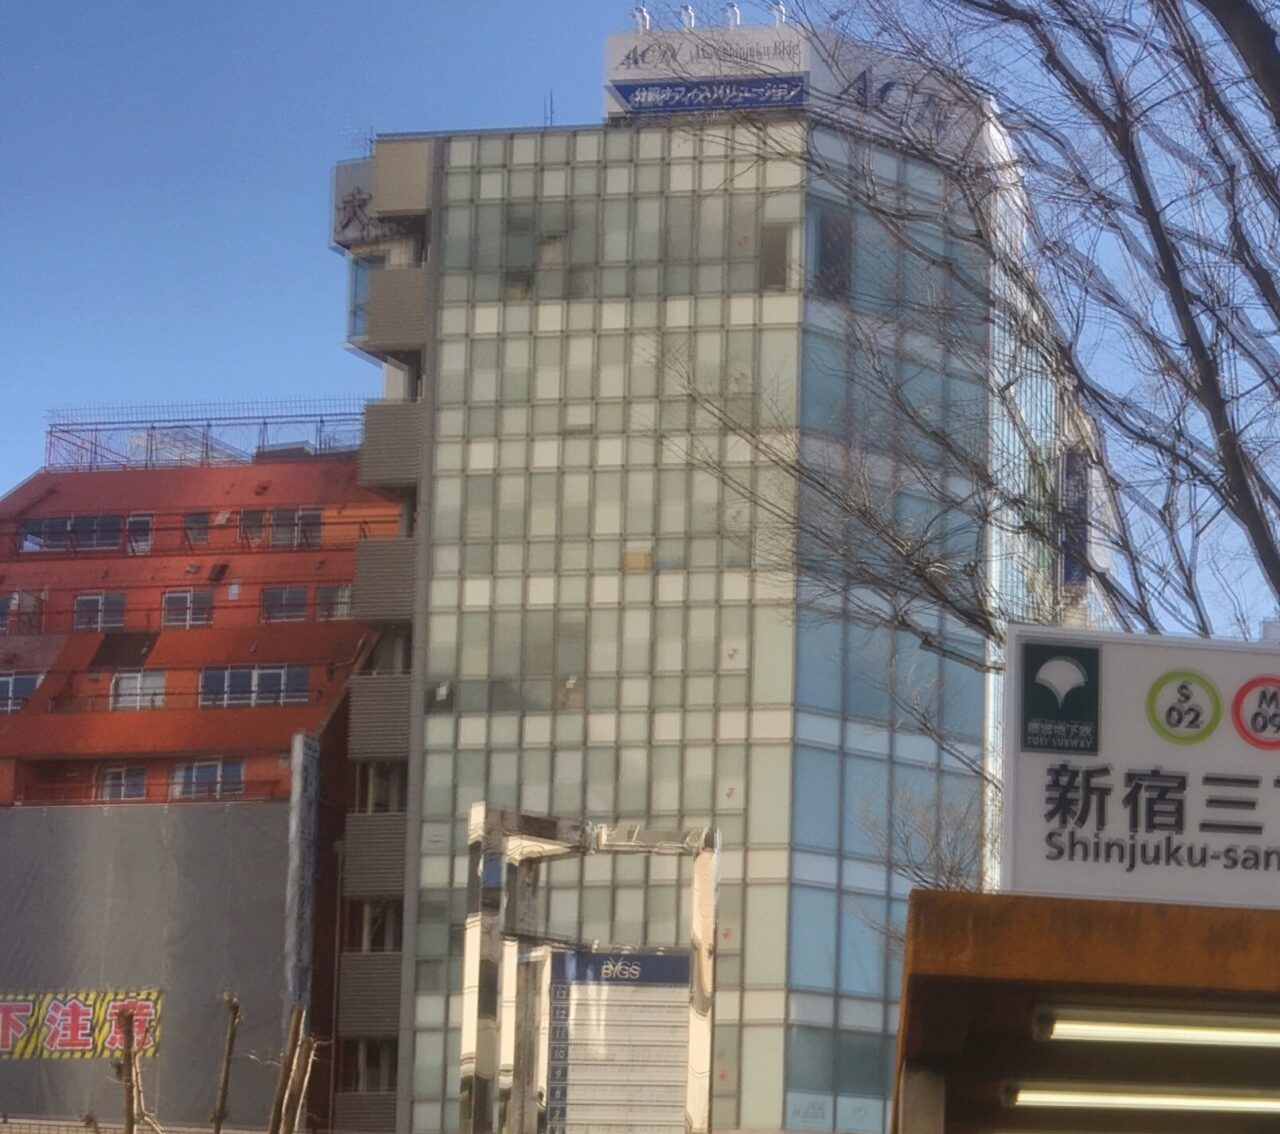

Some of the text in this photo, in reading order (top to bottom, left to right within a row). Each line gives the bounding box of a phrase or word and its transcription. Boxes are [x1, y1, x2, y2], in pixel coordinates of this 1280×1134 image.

[1176, 681, 1191, 703] S
[1258, 688, 1280, 709] M
[1166, 704, 1202, 729] 02
[601, 958, 642, 979] BYGS
